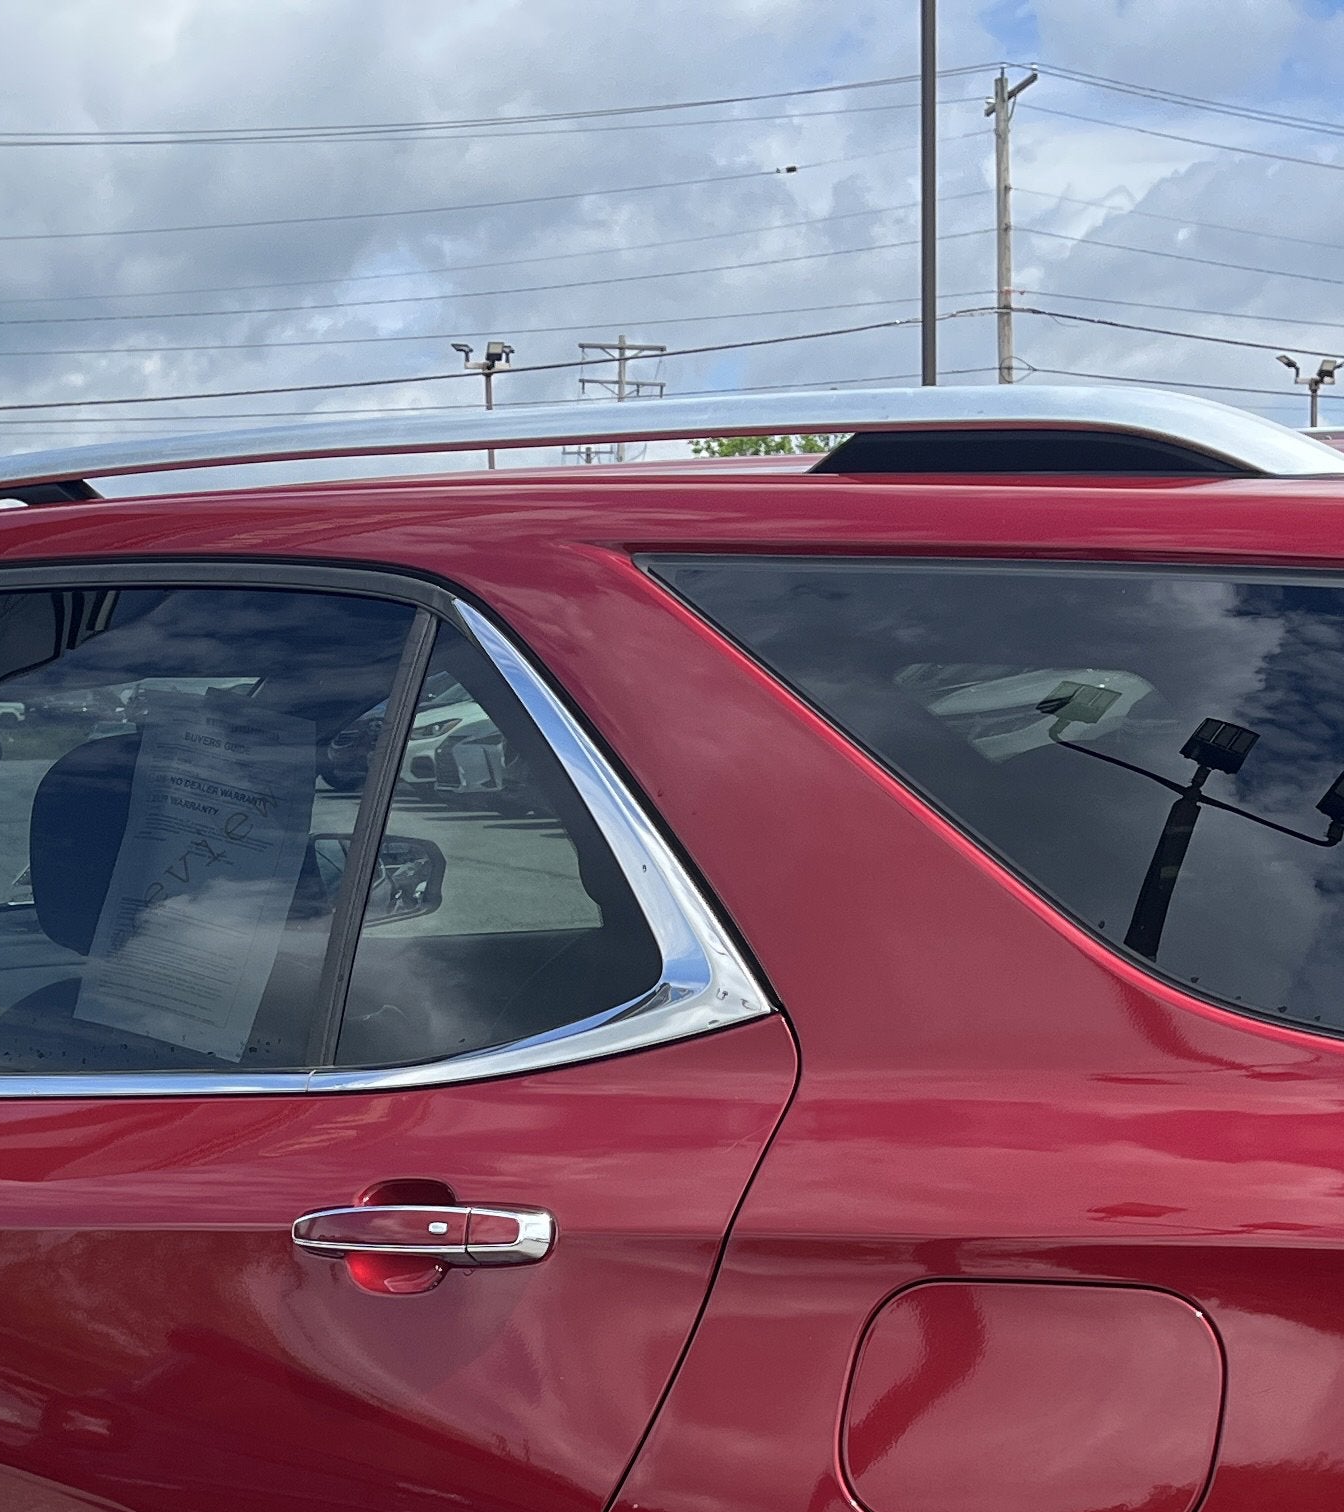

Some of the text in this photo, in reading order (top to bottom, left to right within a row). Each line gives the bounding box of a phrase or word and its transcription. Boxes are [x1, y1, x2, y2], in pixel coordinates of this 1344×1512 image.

[184, 732, 221, 748] BUYERS
[184, 779, 220, 797] DEALER
[168, 797, 220, 816] WARRANTY
